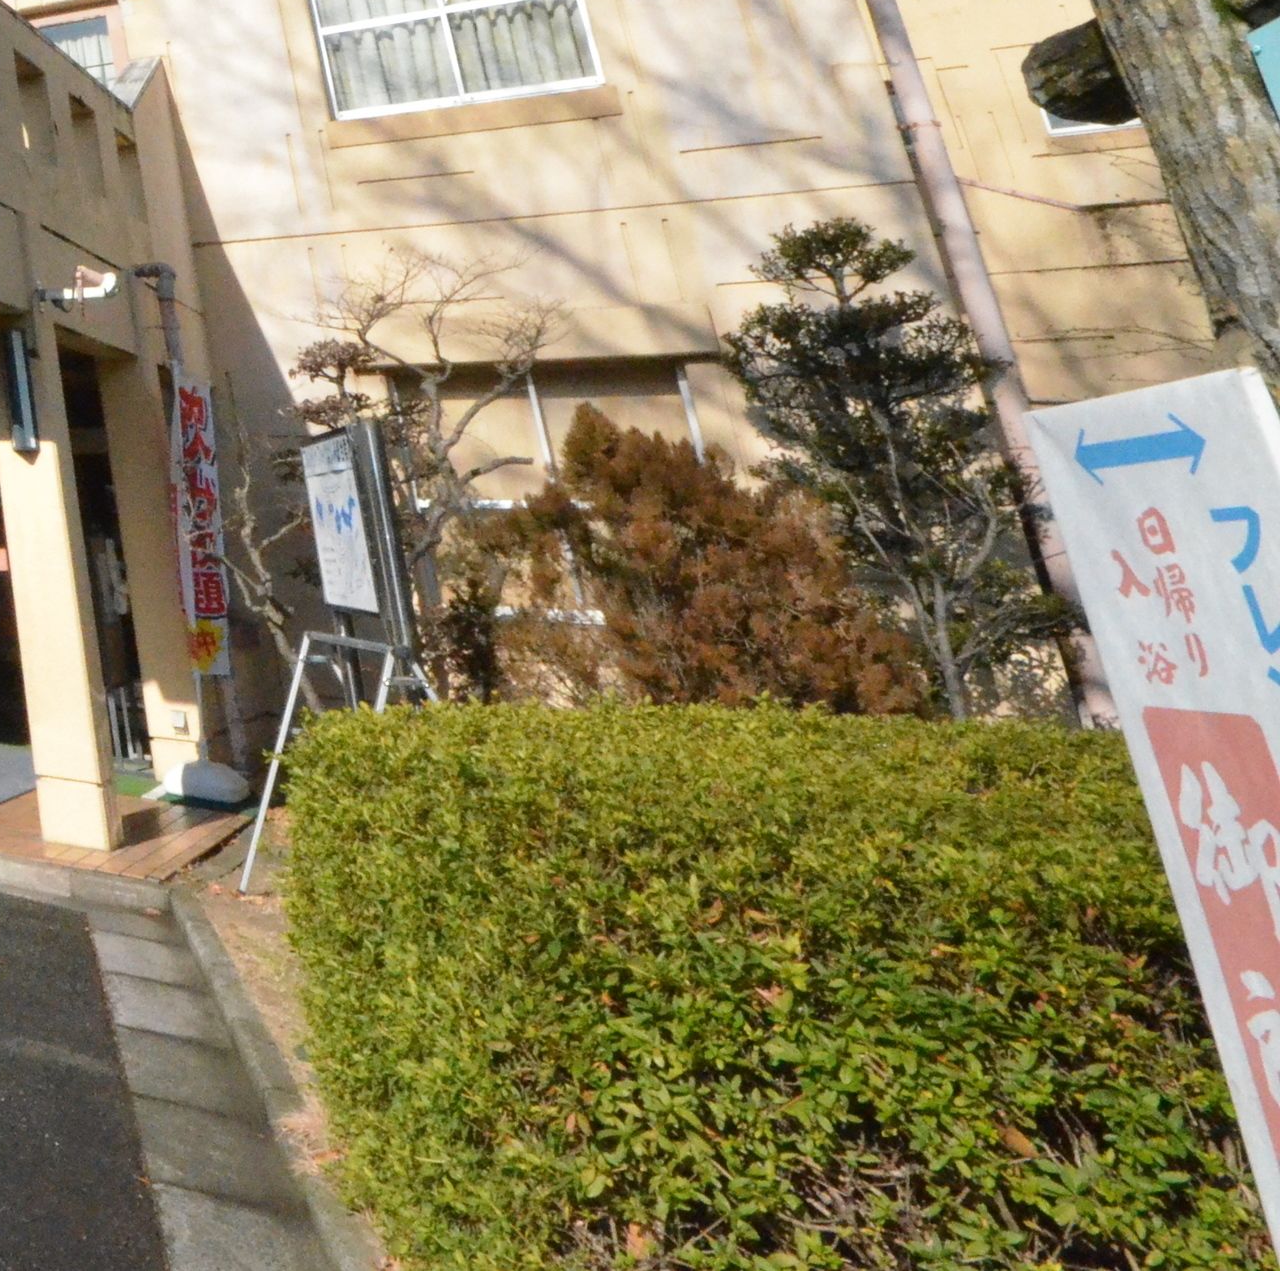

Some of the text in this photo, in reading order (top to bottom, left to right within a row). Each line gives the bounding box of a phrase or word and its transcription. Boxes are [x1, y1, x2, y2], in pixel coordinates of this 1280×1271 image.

[1110, 548, 1179, 686] 入浴
[1136, 506, 1210, 678] 日帰り
